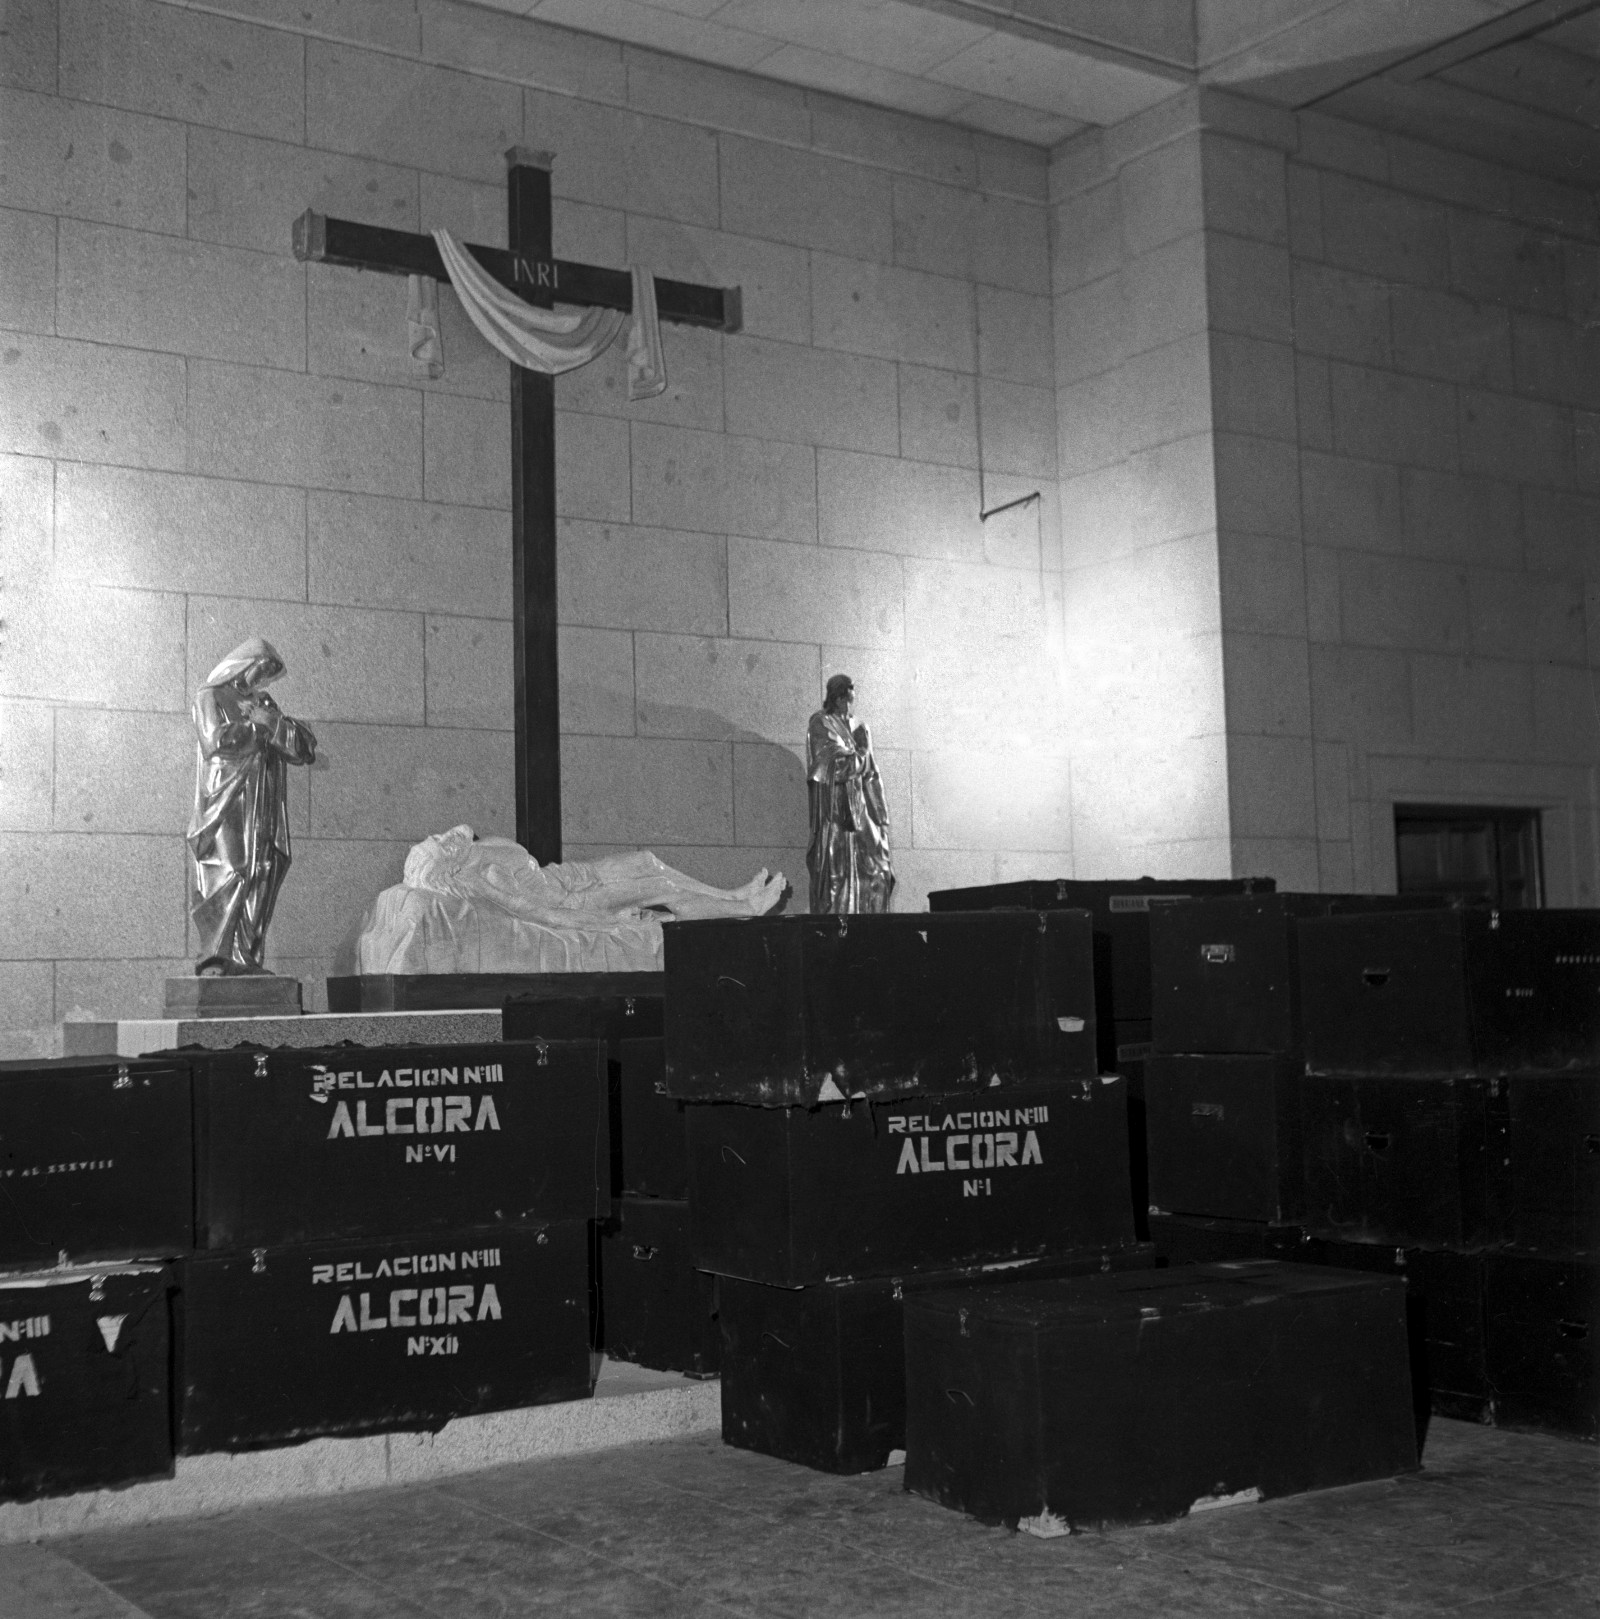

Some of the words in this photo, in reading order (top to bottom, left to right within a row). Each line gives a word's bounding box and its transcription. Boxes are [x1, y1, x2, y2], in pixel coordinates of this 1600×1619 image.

[513, 257, 558, 289] INRI
[312, 1066, 459, 1092] RELACION
[326, 1094, 502, 1140] ALCORA
[887, 1109, 1011, 1134] RELACION
[896, 1130, 1044, 1174] ALCORA
[311, 1252, 457, 1285] RELACION
[329, 1283, 503, 1335] ALCORA
